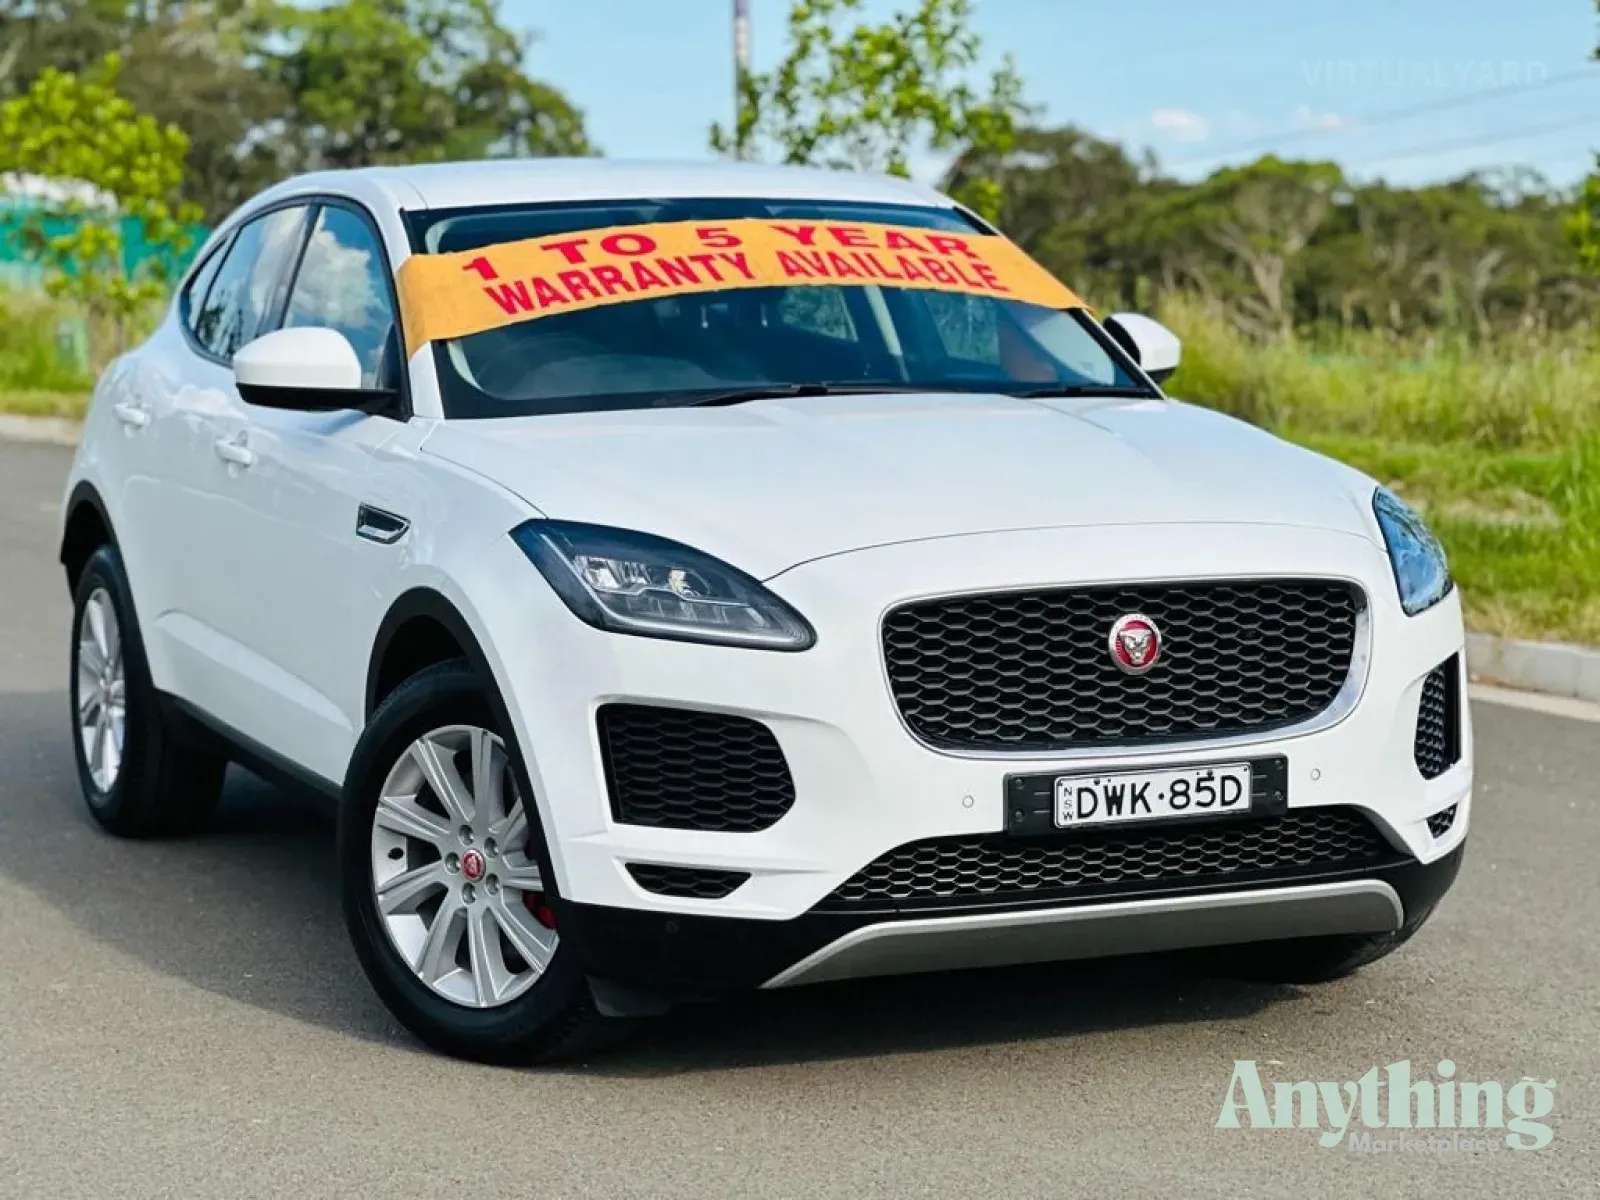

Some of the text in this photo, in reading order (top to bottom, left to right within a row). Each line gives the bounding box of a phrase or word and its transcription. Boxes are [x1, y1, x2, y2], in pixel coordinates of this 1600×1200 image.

[462, 225, 977, 281] 1 TO 5 YEAR
[483, 249, 1010, 316] WARRANTY AVAILABLE
